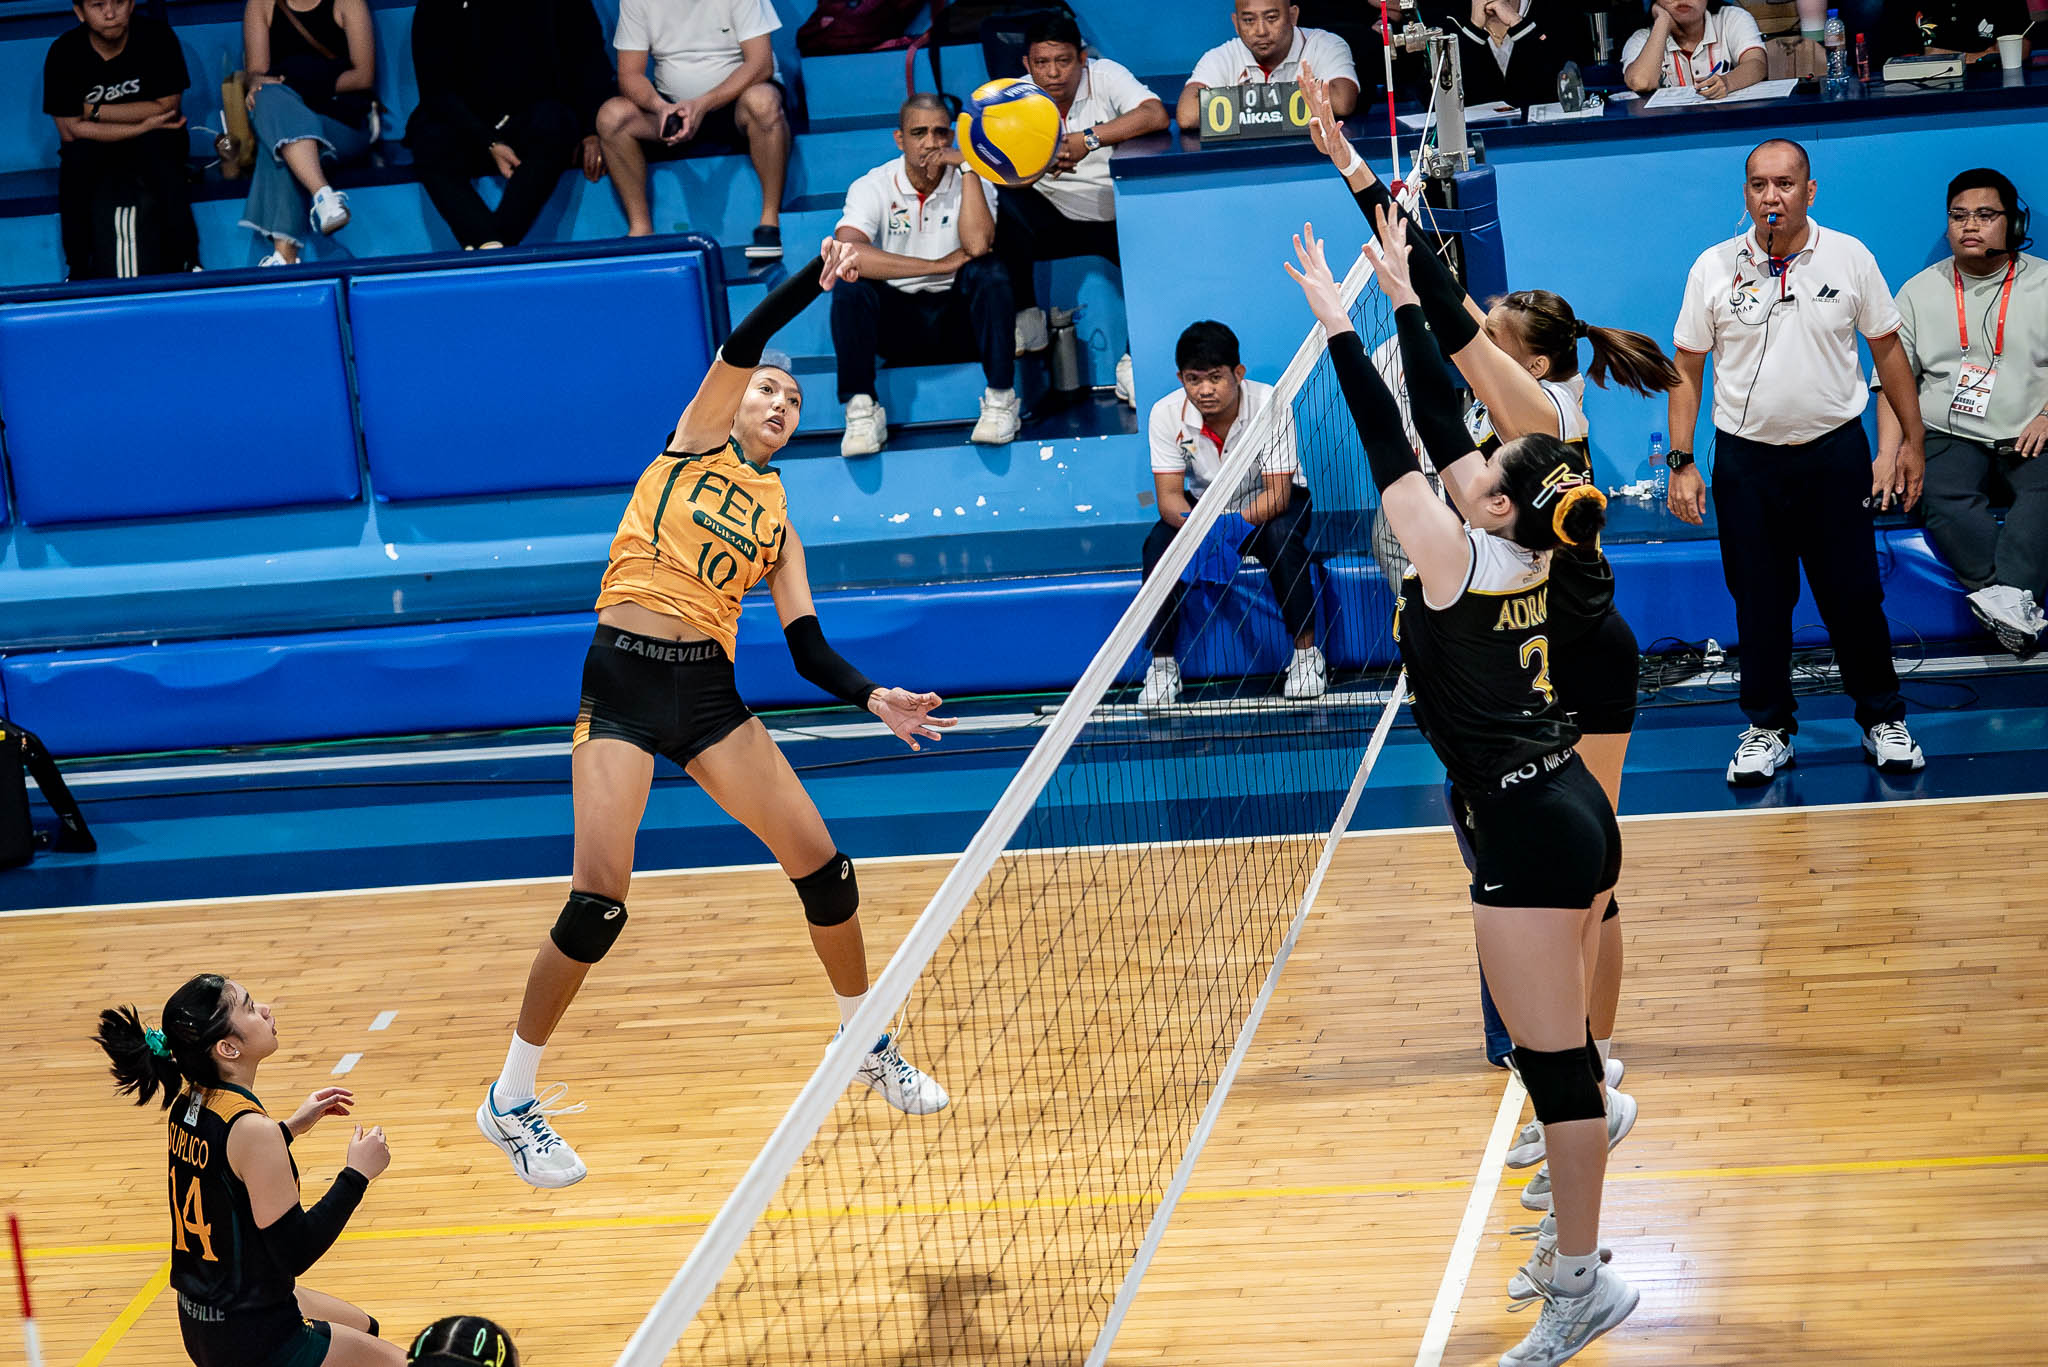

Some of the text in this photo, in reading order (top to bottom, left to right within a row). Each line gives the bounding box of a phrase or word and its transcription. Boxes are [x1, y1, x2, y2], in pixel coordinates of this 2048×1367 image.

[1208, 95, 1233, 133] 0
[1239, 107, 1284, 125] MiKAS
[1245, 88, 1280, 107] 0 1
[1289, 89, 1313, 127] 0
[686, 470, 781, 548] FEU
[702, 516, 754, 557] DILIMAN
[696, 541, 738, 591] 10
[614, 634, 720, 662] GAMEVILLE
[1500, 762, 1538, 790] RO
[168, 1121, 209, 1170] SUPLICO
[170, 1165, 219, 1262] 14
